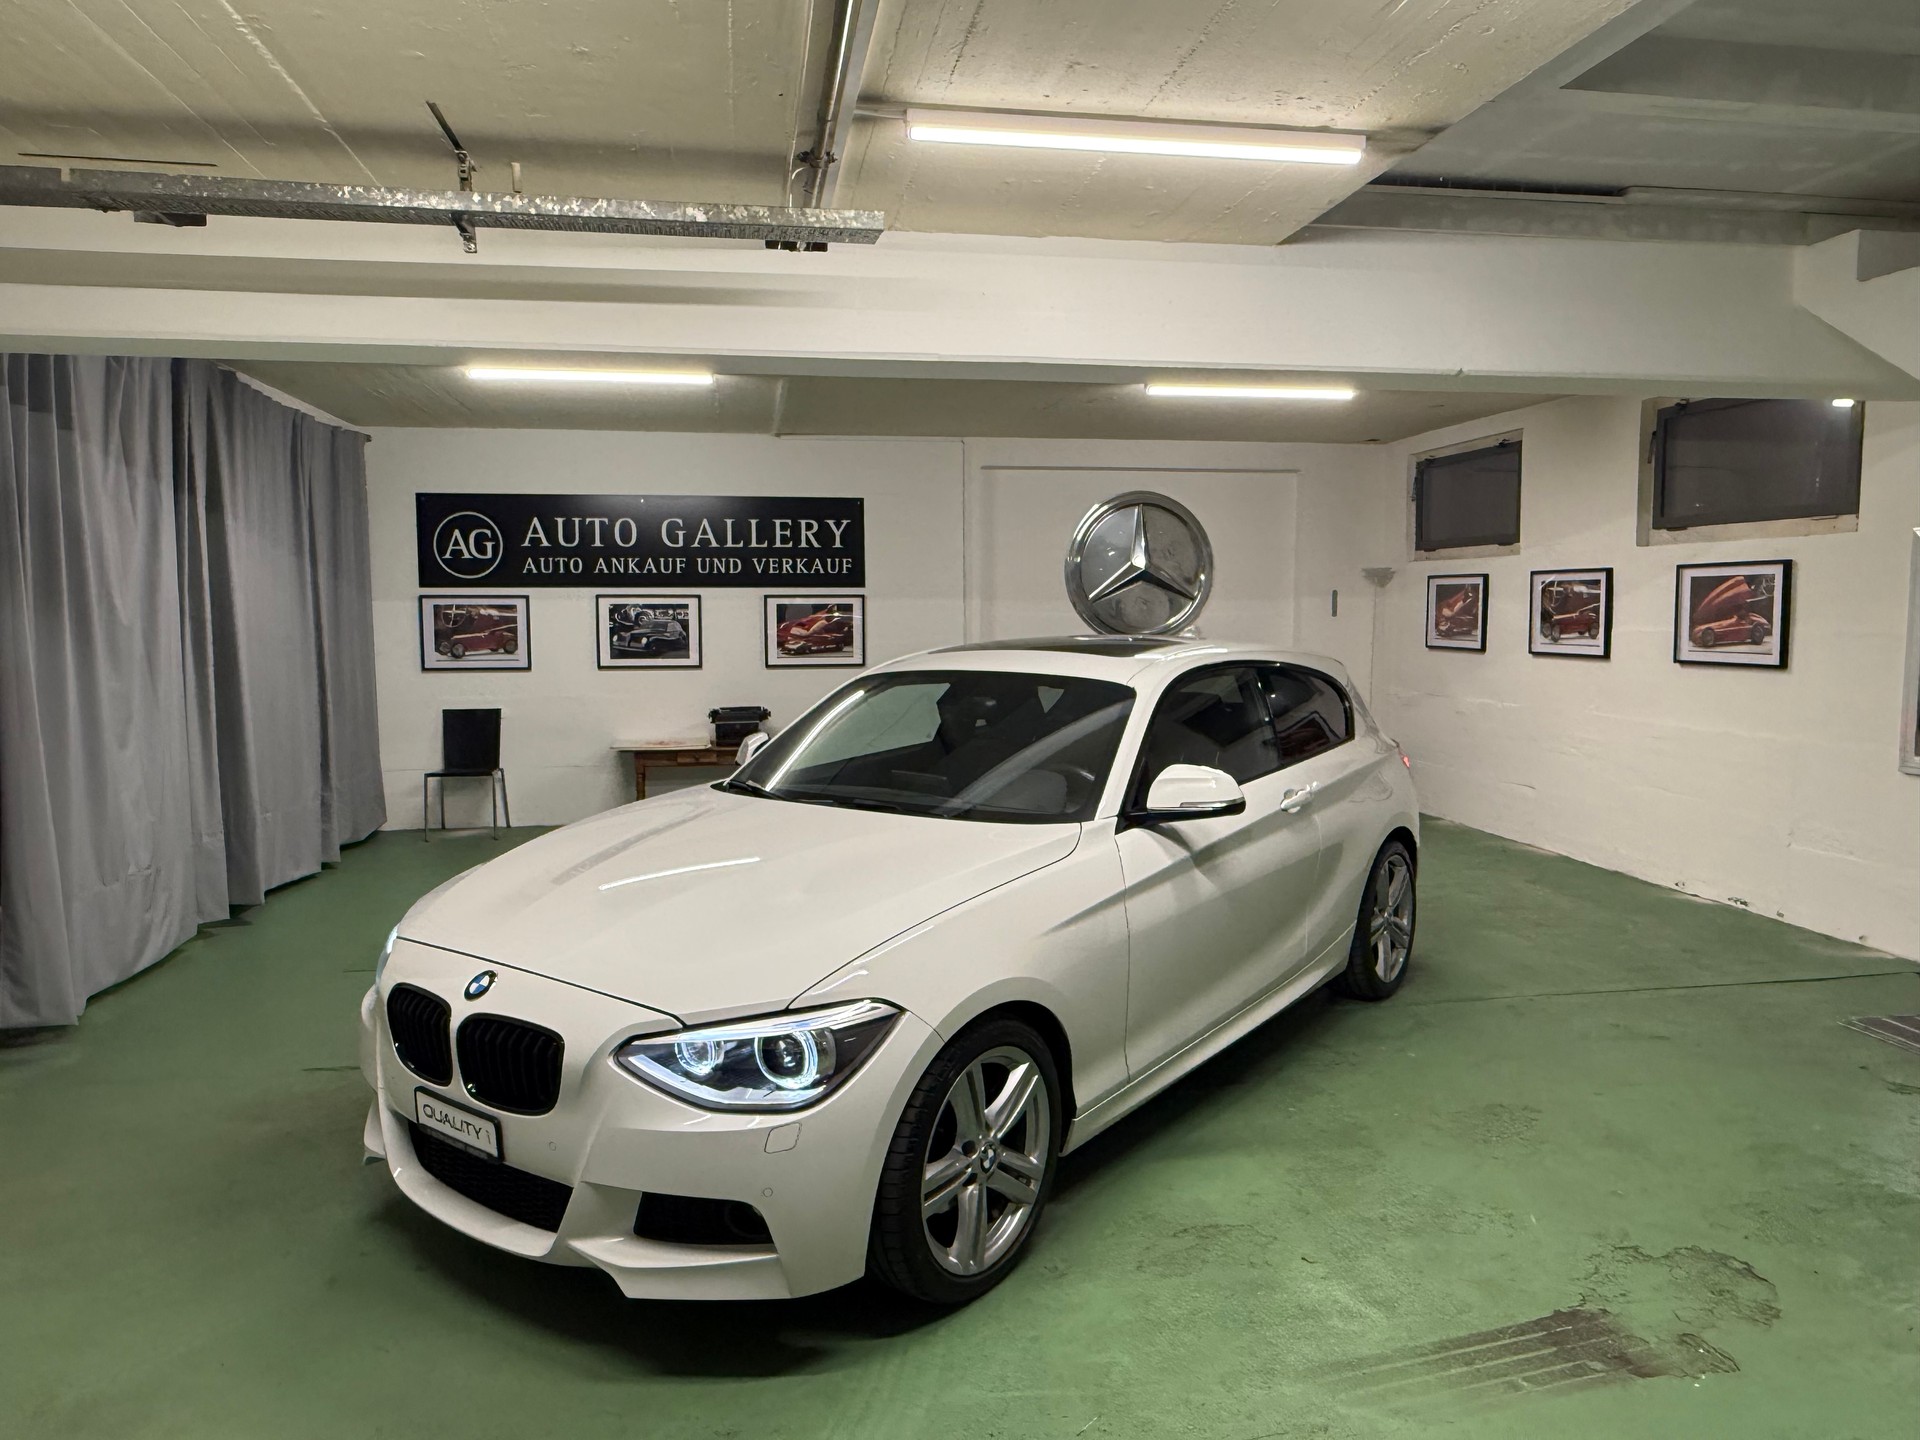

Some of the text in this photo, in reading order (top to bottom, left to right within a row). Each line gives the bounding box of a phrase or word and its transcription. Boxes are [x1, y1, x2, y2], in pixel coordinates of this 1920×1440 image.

[442, 528, 496, 559] AG
[521, 516, 851, 549] AUTO GALLERY
[522, 557, 853, 575] AUTO ANKAUF UND VERKAUF
[422, 1103, 482, 1140] QUALITY
